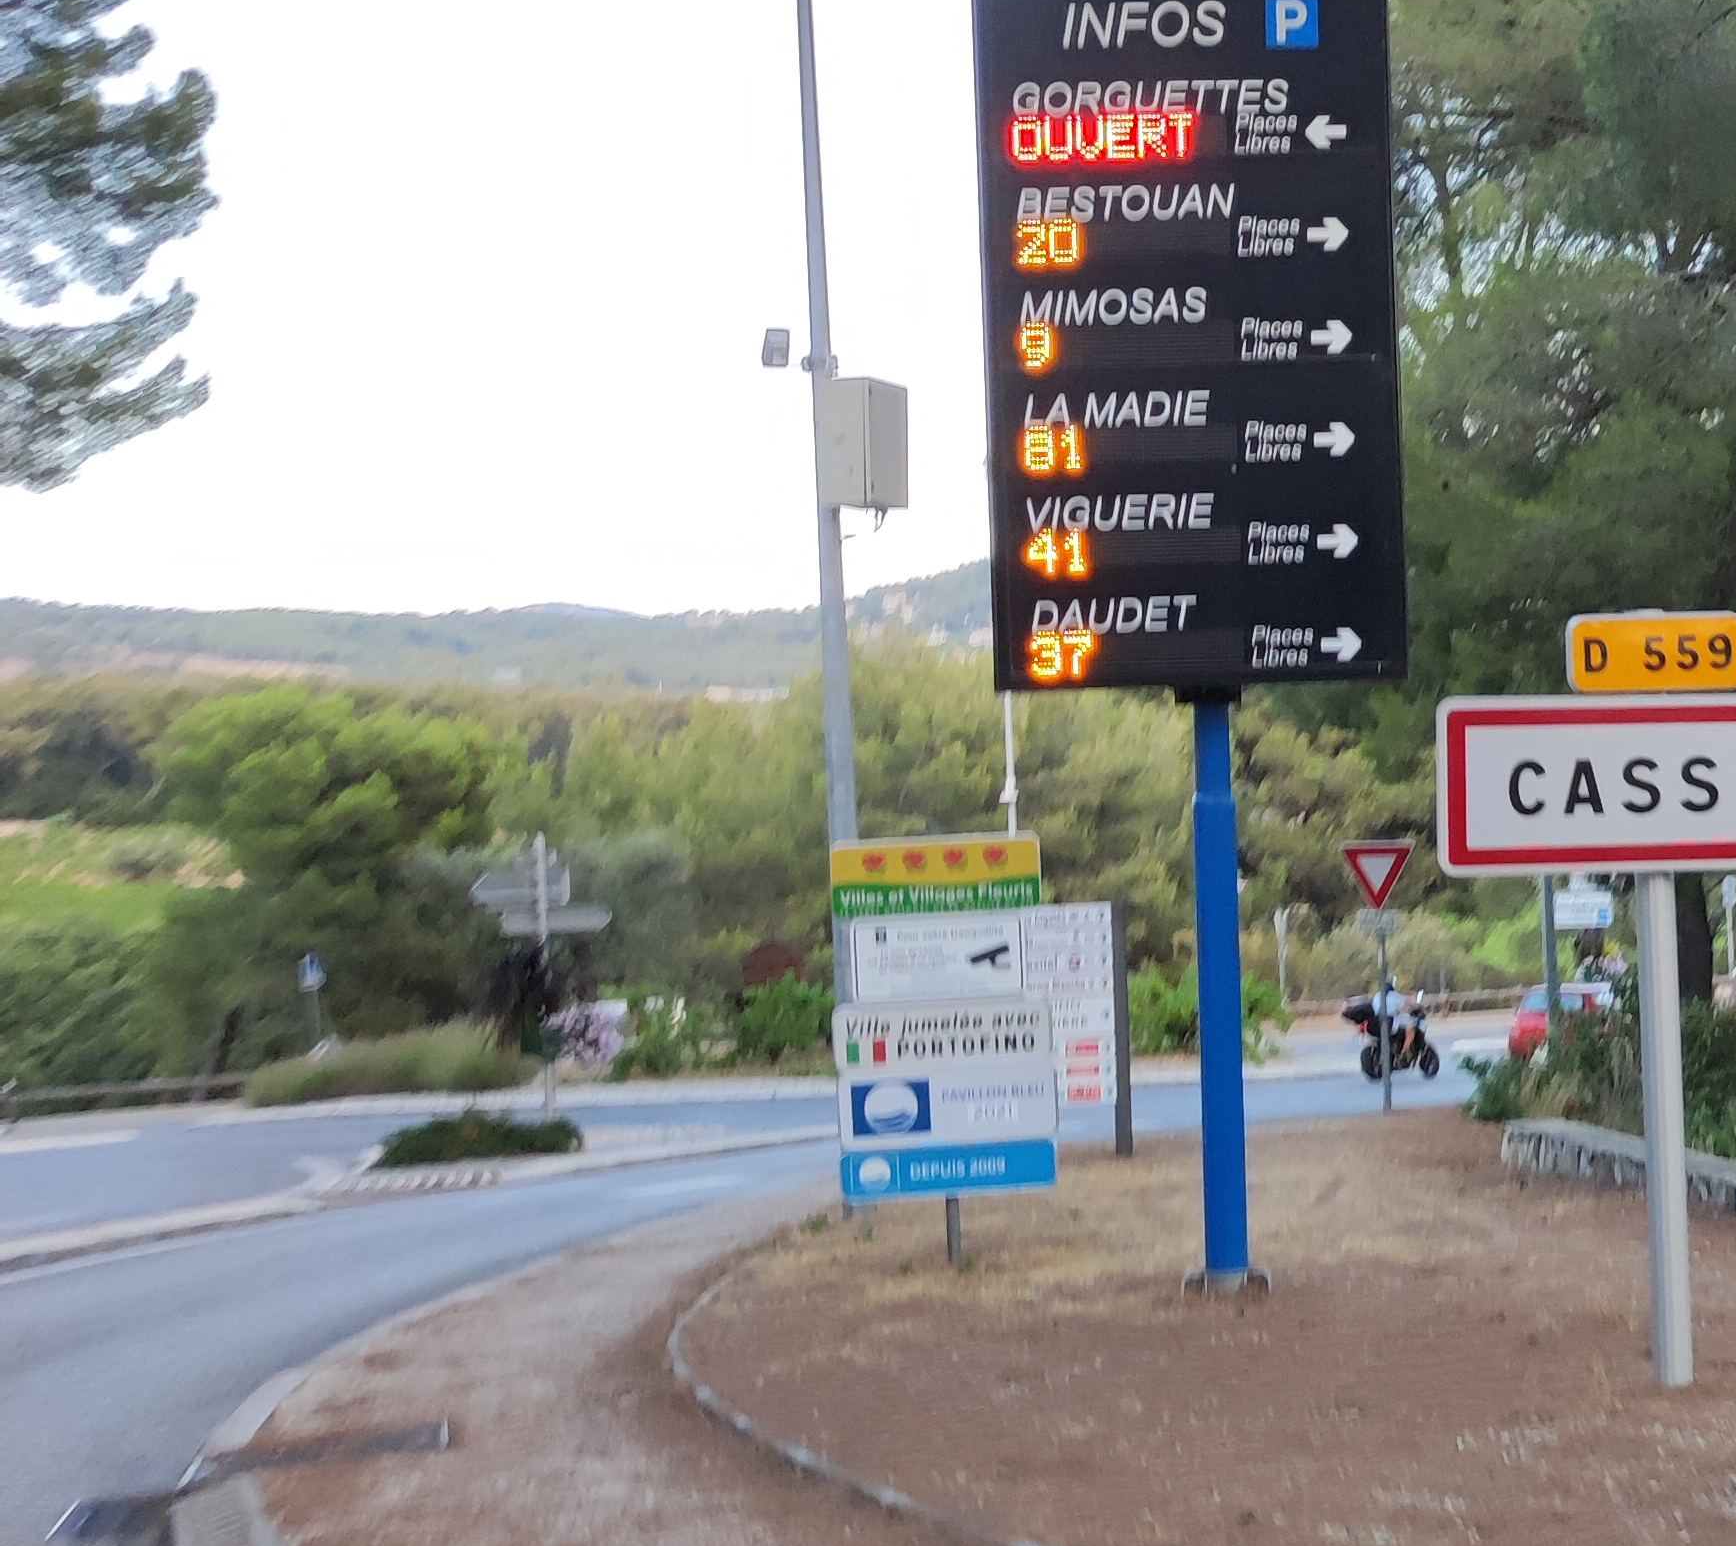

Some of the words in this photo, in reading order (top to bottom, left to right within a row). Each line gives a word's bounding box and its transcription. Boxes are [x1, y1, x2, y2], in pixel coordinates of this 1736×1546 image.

[1062, 0, 1227, 50] INFOS
[1012, 78, 1289, 117] GORGUETTES
[1011, 112, 1194, 162] OUVERT
[1236, 112, 1298, 136] Places
[1234, 133, 1292, 156] Libres
[1017, 183, 1235, 222] BESTOUAN
[1016, 218, 1080, 266] 20
[1238, 215, 1300, 239] Places
[1238, 236, 1296, 259] Libres
[1020, 286, 1208, 327] MIMOSAS
[1019, 320, 1052, 368] 9
[1241, 317, 1303, 341] Places
[1241, 338, 1299, 361] Libres
[1023, 392, 1071, 429] LA
[1084, 389, 1211, 429] MADIE
[1245, 420, 1307, 444] Places
[1023, 424, 1083, 472] 81
[1245, 441, 1303, 464] Libres
[1026, 492, 1215, 534] VIGUERIE
[1248, 521, 1310, 545] Places
[1028, 526, 1087, 574] 41
[1248, 542, 1306, 565] Libres
[1032, 594, 1198, 635] DAUDET
[1252, 625, 1314, 649] Places
[1030, 629, 1094, 676] 37
[1252, 646, 1310, 669] Libres
[1584, 638, 1608, 674] D
[1643, 633, 1733, 672] 559
[846, 1014, 890, 1039] Ville
[991, 1010, 1040, 1030] avec
[897, 1030, 1036, 1061] PORTOFINO
[941, 1084, 1008, 1103] PAVILLON
[910, 1157, 966, 1182] DEPUIS
